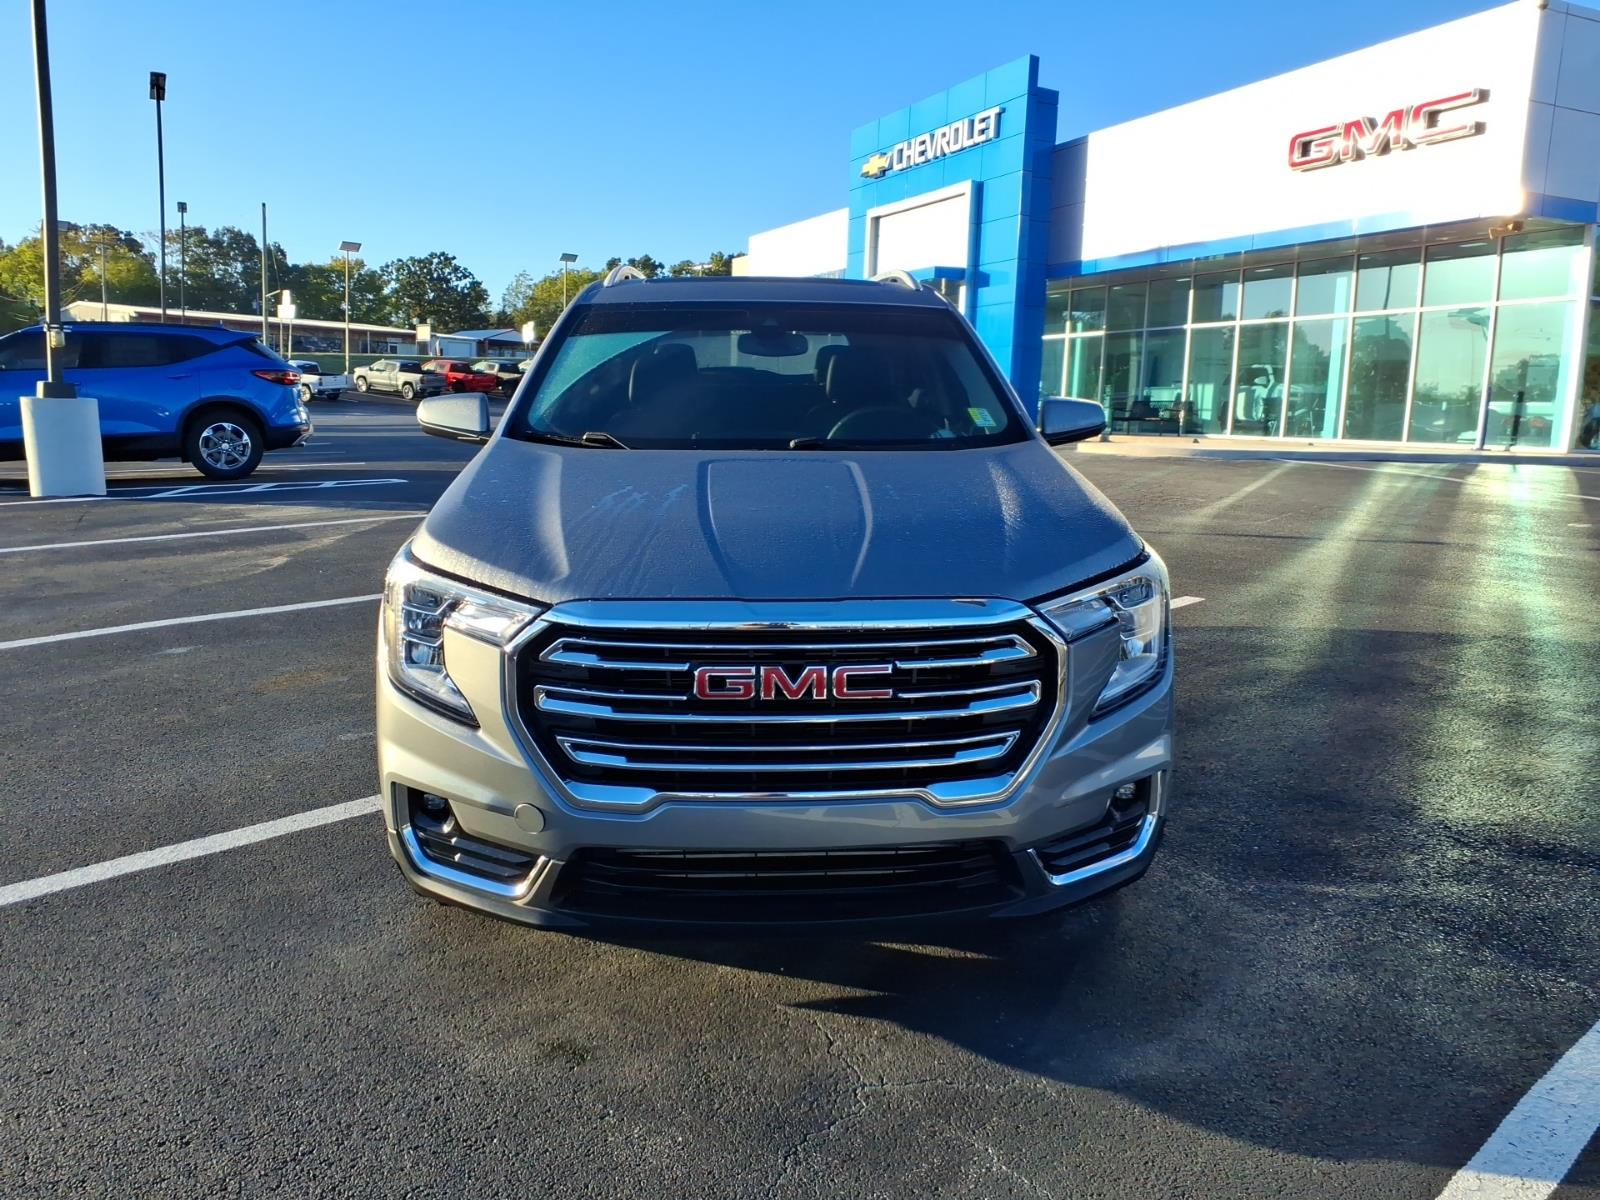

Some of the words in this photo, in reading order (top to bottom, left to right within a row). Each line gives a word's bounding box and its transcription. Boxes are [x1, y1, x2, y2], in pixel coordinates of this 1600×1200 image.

[892, 106, 1004, 171] CHEVROLET
[1288, 88, 1488, 172] GMC
[694, 664, 893, 700] GMC
